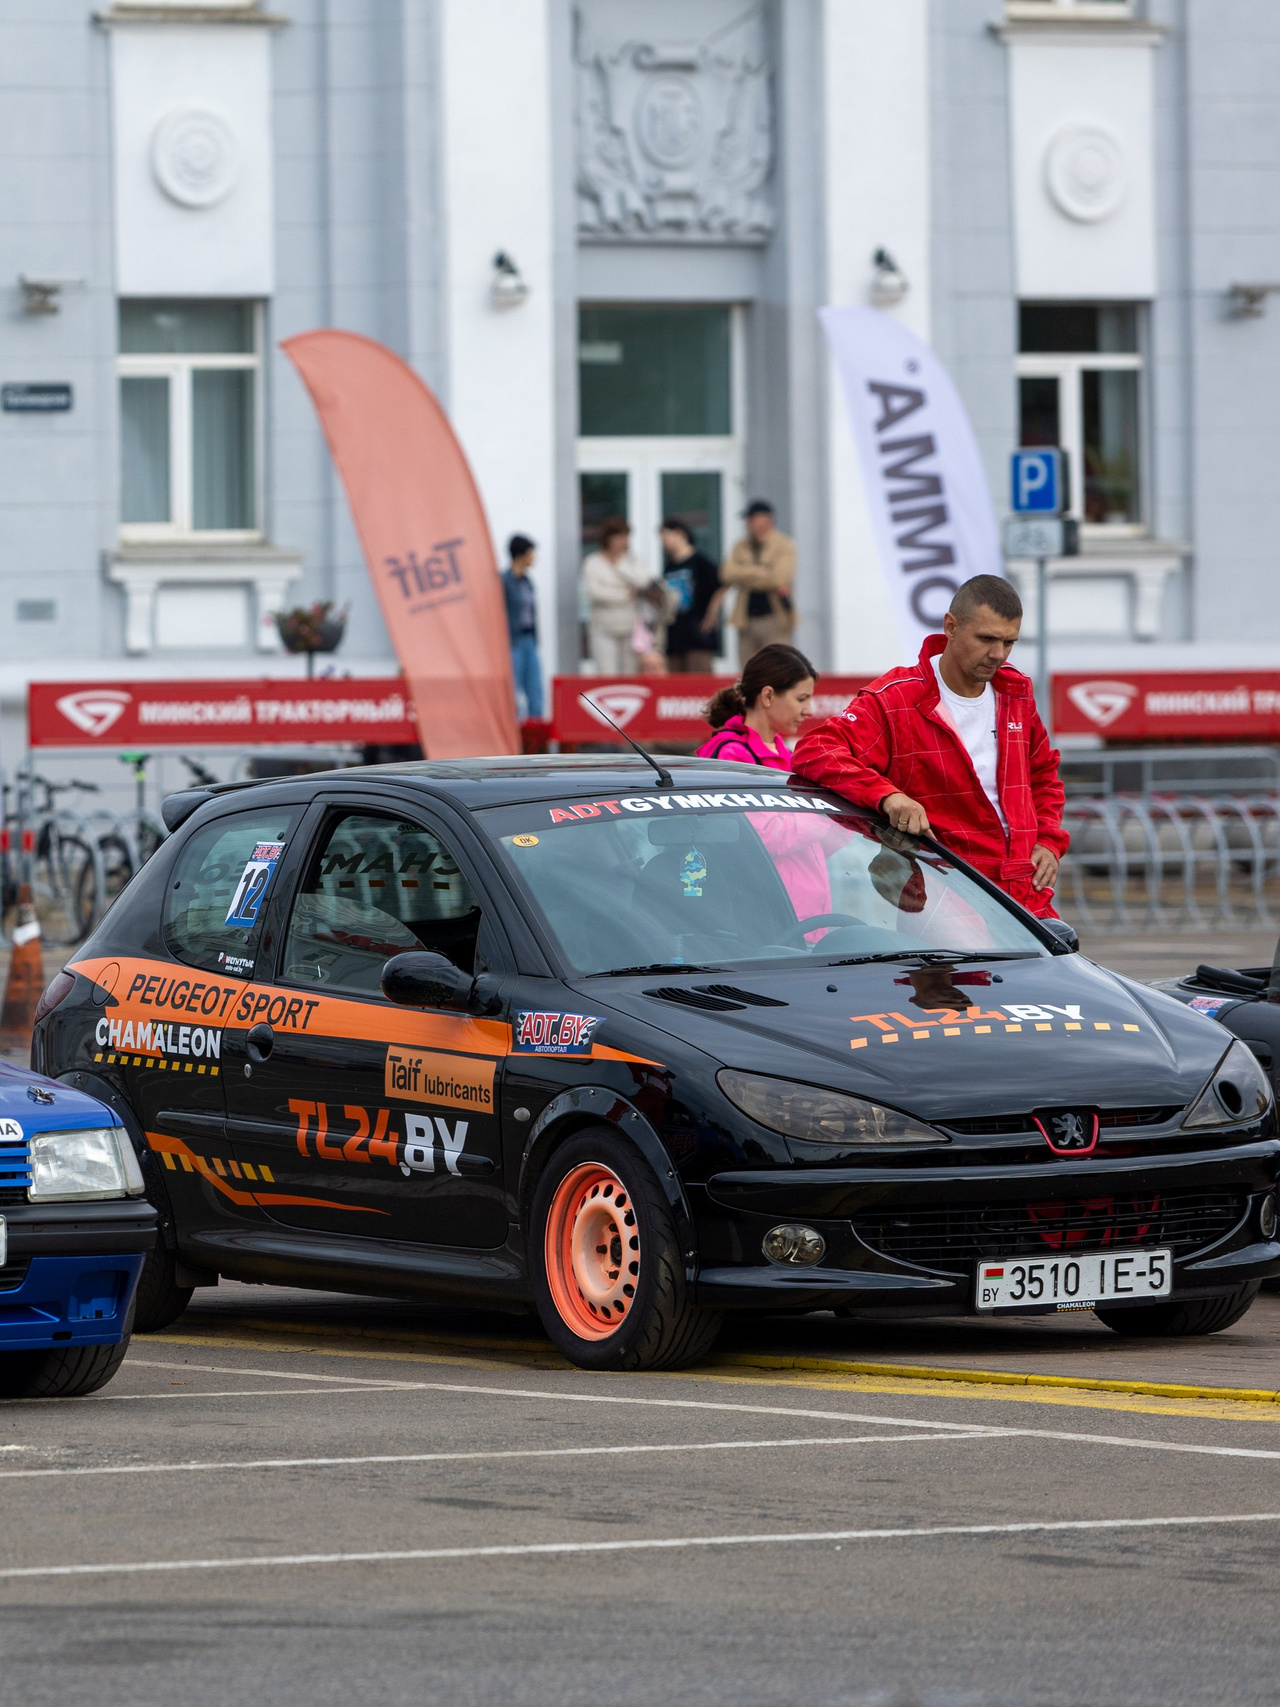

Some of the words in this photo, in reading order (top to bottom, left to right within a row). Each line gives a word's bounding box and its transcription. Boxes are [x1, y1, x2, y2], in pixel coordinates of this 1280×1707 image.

[1019, 457, 1047, 507] P
[139, 695, 251, 725] МИНСКИЙ
[256, 693, 404, 724] ТРАКТОРНЫЙ
[549, 793, 842, 824] ADTGYMKHANA
[233, 867, 270, 919] 12
[126, 973, 236, 1018] PEUGEOT
[237, 991, 320, 1029] SPORT
[850, 1004, 1085, 1031] TL24.BY
[520, 1013, 592, 1047] ADT.BY
[534, 1045, 567, 1053] АВТОПОРТАЛ
[388, 1055, 423, 1093] Taif
[424, 1075, 491, 1104] lubricants
[288, 1098, 469, 1177] TL24.BY
[982, 1287, 1000, 1303] BY
[1009, 1262, 1080, 1300] 3510
[1100, 1255, 1165, 1294] IE-5
